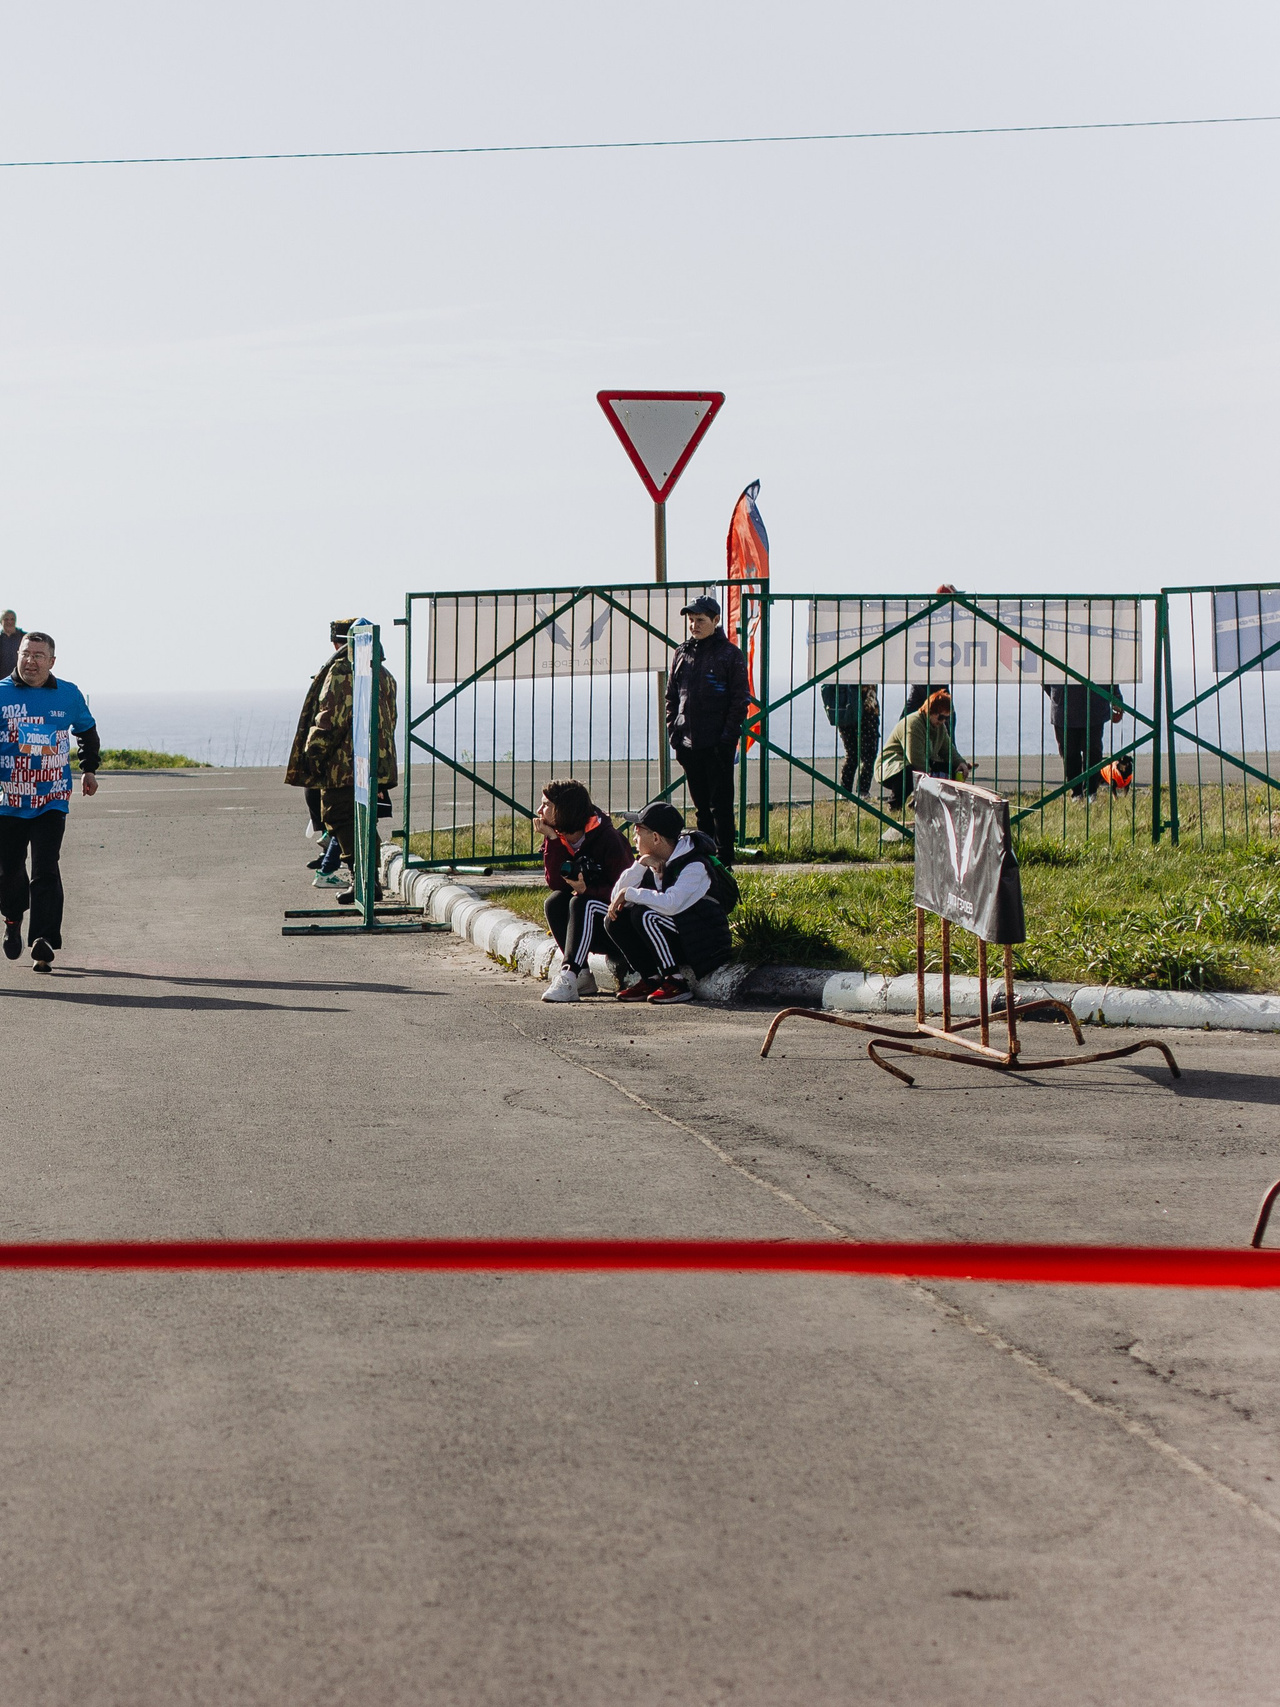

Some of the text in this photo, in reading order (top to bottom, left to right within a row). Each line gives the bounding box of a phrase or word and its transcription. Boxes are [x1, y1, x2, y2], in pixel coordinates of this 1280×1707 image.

[2, 703, 27, 719] 2024
[27, 733, 50, 744] 20035
[0, 755, 32, 770] #ЗАБЕГ
[10, 767, 64, 783] #ГОРДОСТЬ
